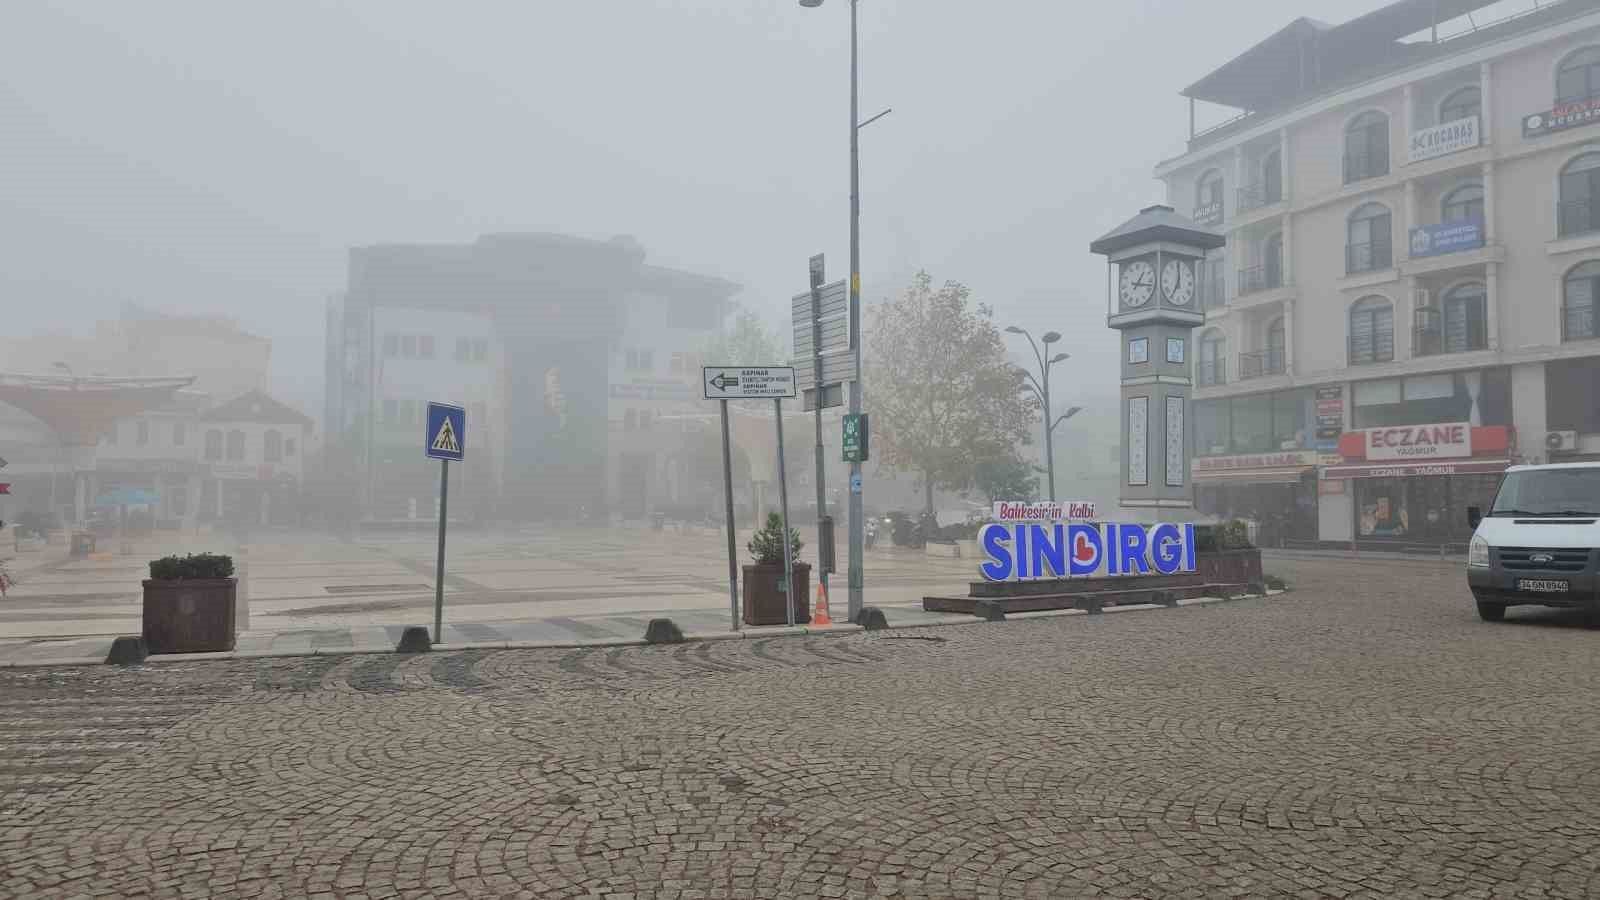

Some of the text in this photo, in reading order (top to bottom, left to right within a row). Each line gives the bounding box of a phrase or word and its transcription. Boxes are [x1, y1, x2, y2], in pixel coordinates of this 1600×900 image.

[1371, 425, 1465, 448] ECZANE
[1369, 467, 1408, 477] ECZANE
[1069, 503, 1096, 518] Kalbi
[978, 523, 1196, 581] SINDIRGI
